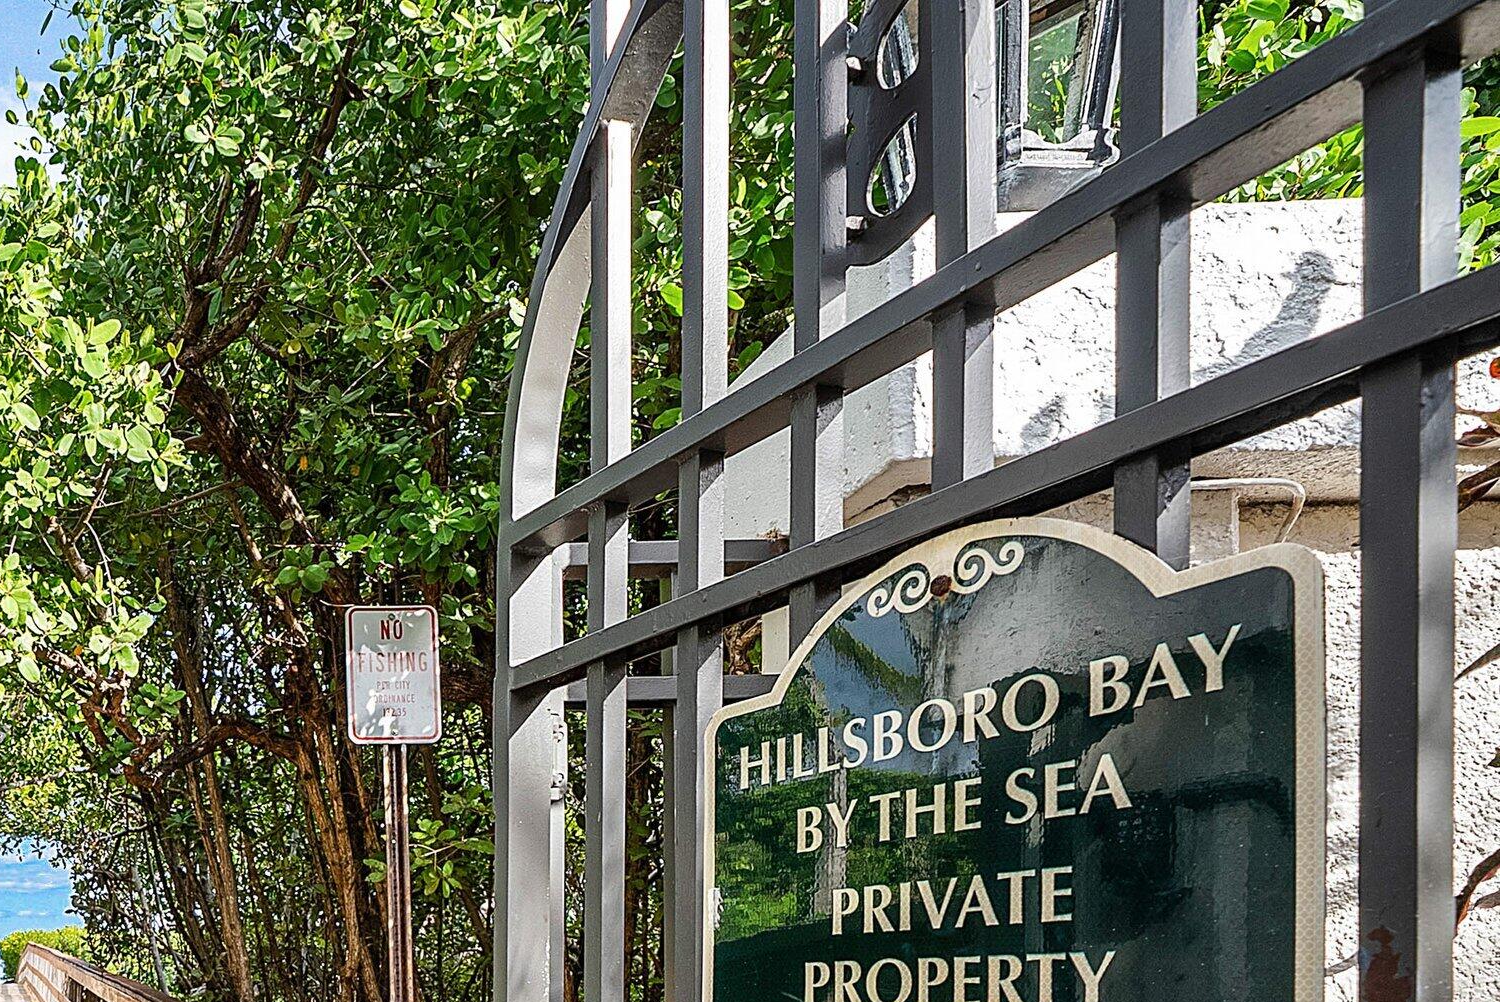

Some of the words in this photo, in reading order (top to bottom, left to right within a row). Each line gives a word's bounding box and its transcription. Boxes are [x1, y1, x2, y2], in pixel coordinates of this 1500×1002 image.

[380, 619, 403, 640] NO
[357, 652, 428, 673] FISHING
[376, 680, 391, 690] PER
[394, 680, 411, 690] CITY
[373, 693, 416, 704] ORDINANCE
[740, 673, 1060, 790] HILLSBORO
[1088, 624, 1243, 716] BAY
[796, 799, 857, 854] BY
[870, 778, 982, 843] THE
[1005, 753, 1133, 826] SEA
[831, 866, 1074, 936] PRIVATE
